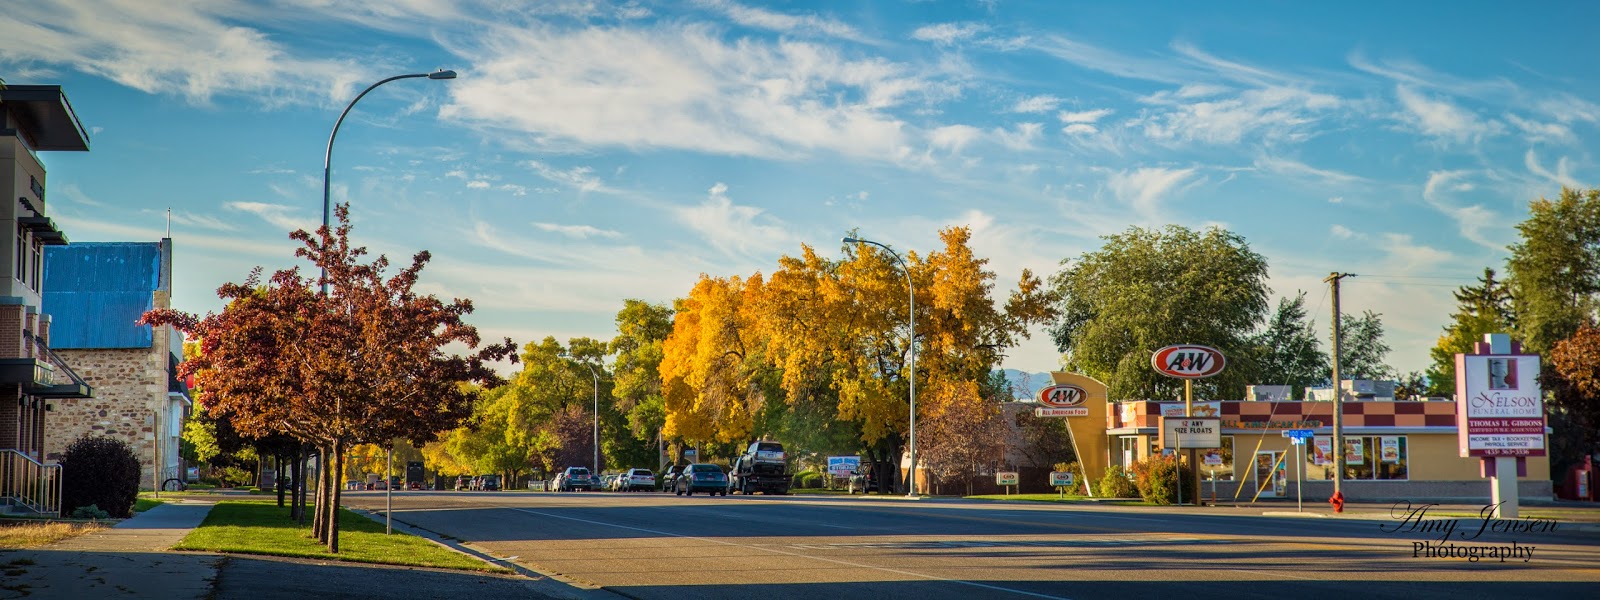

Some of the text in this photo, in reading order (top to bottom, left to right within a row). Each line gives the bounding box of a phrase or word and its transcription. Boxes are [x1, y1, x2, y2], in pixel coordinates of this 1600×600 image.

[1166, 352, 1213, 371] A&W
[1048, 390, 1079, 402] A&W
[1471, 392, 1537, 408] NELSON
